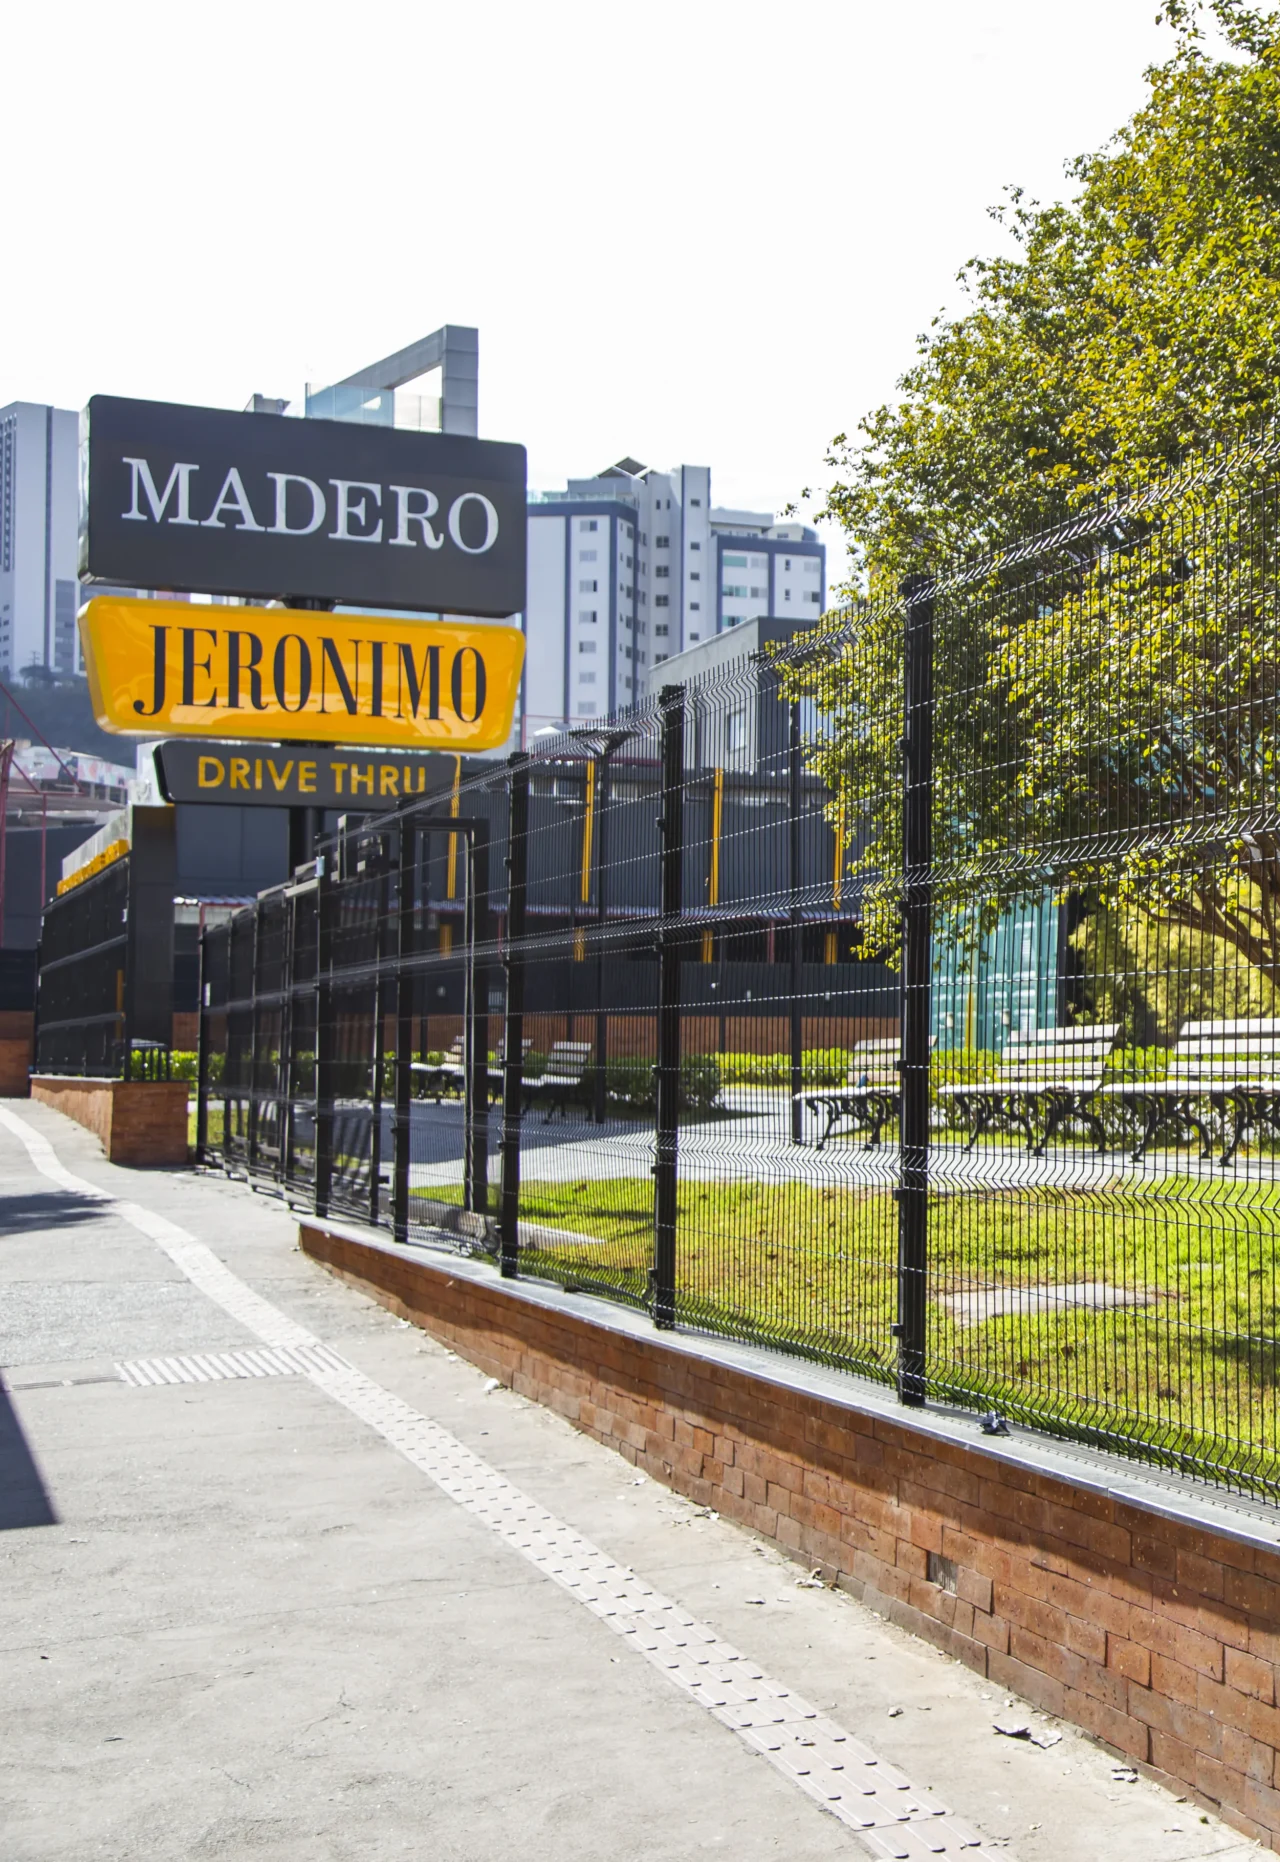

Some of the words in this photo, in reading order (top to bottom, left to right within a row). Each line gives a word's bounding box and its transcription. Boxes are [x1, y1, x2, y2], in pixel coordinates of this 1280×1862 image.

[121, 456, 499, 554] MADERO
[133, 624, 487, 723] JERONIMO
[198, 756, 317, 793] DRIVE
[330, 762, 426, 796] THRU
